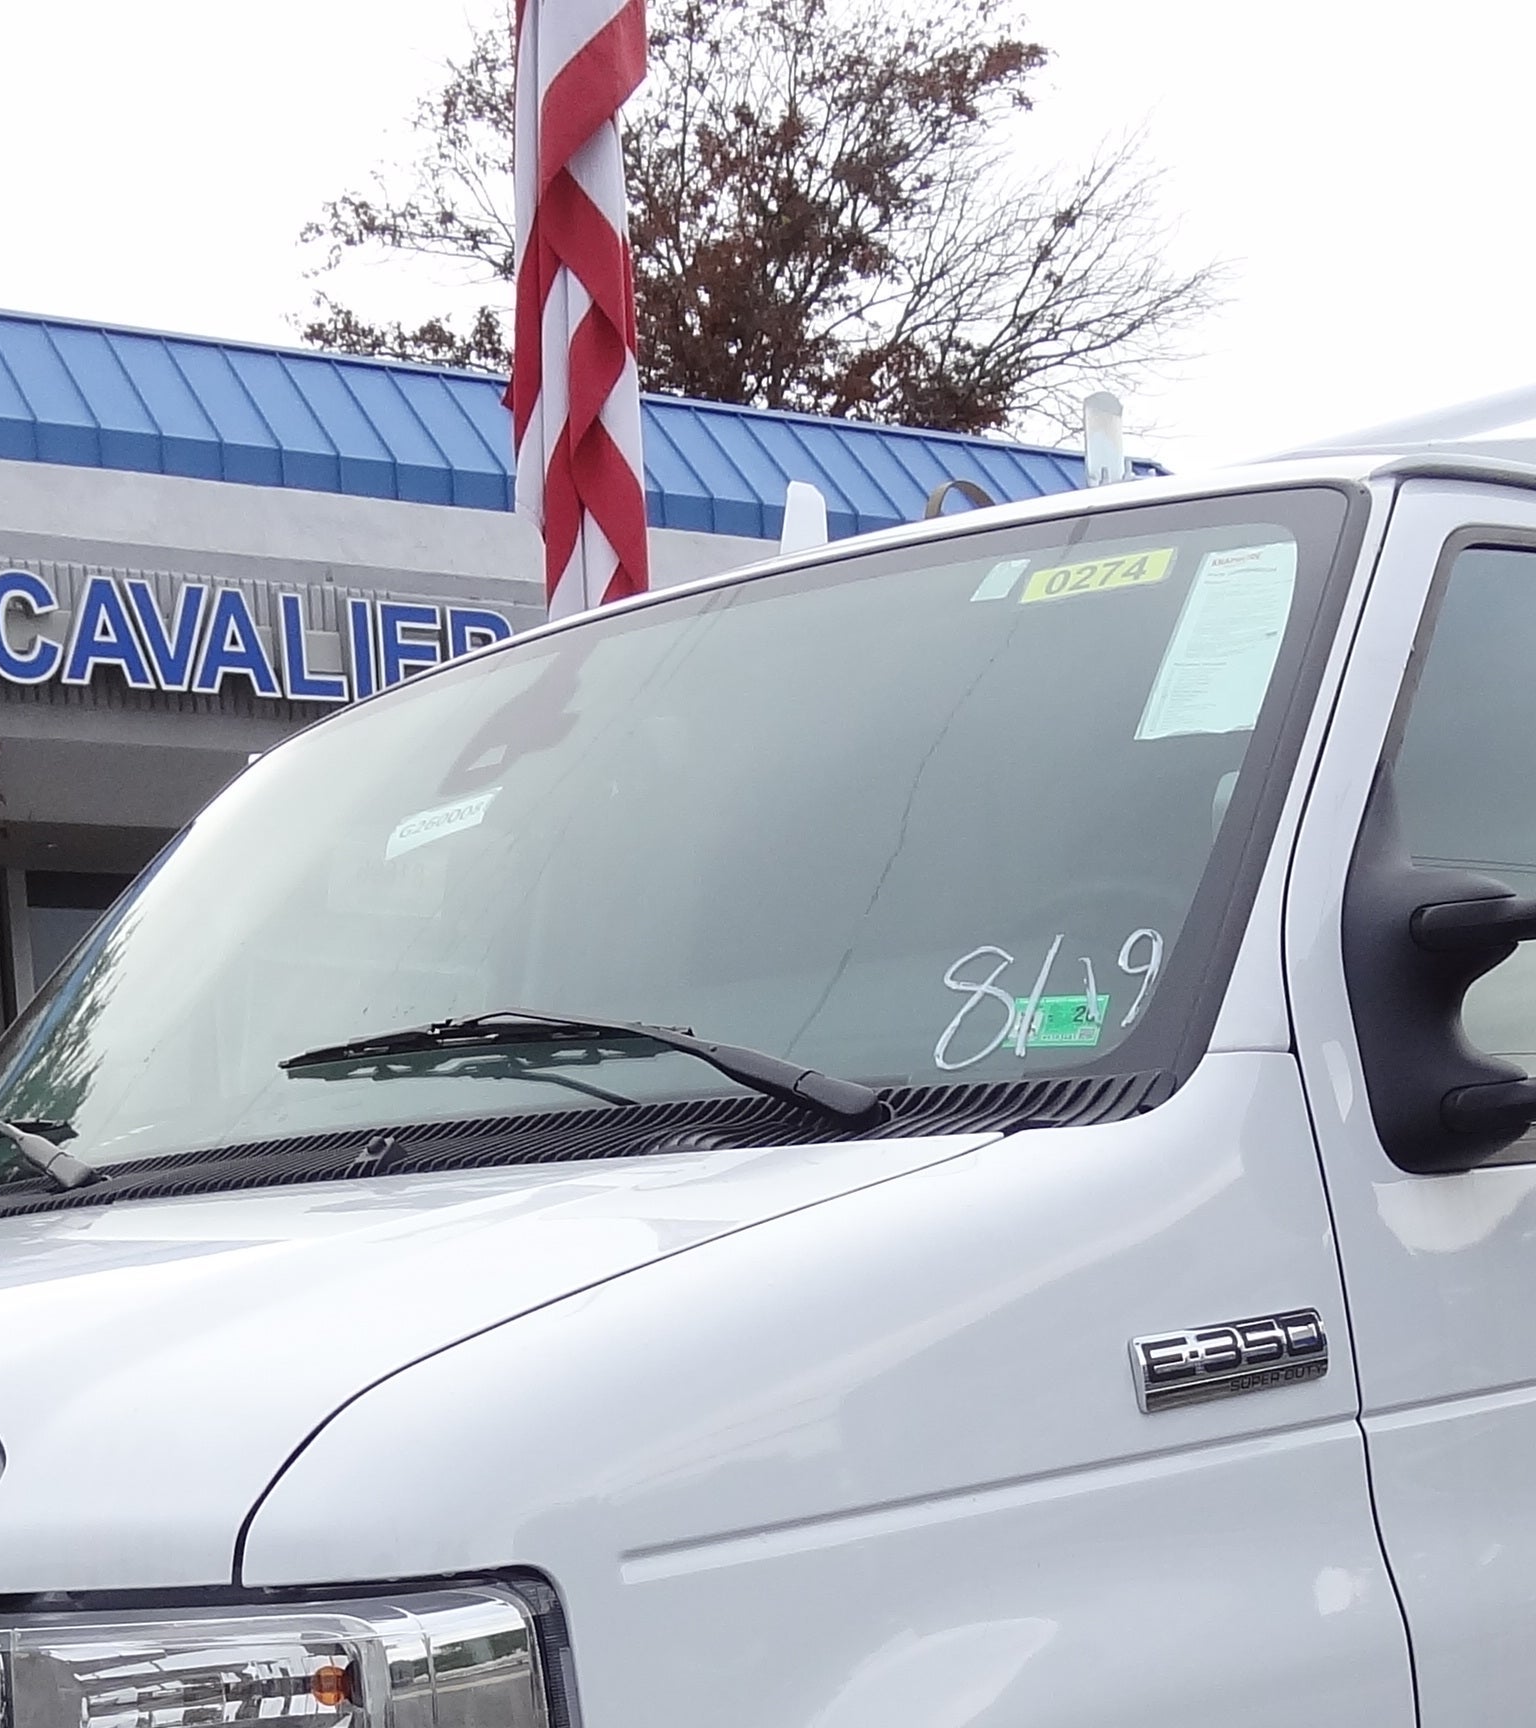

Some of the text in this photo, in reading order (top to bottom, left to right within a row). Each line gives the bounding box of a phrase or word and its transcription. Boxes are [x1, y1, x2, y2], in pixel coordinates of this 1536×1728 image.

[1044, 556, 1147, 597] 0274
[1230, 1364, 1326, 1392] SUPER DUTY
